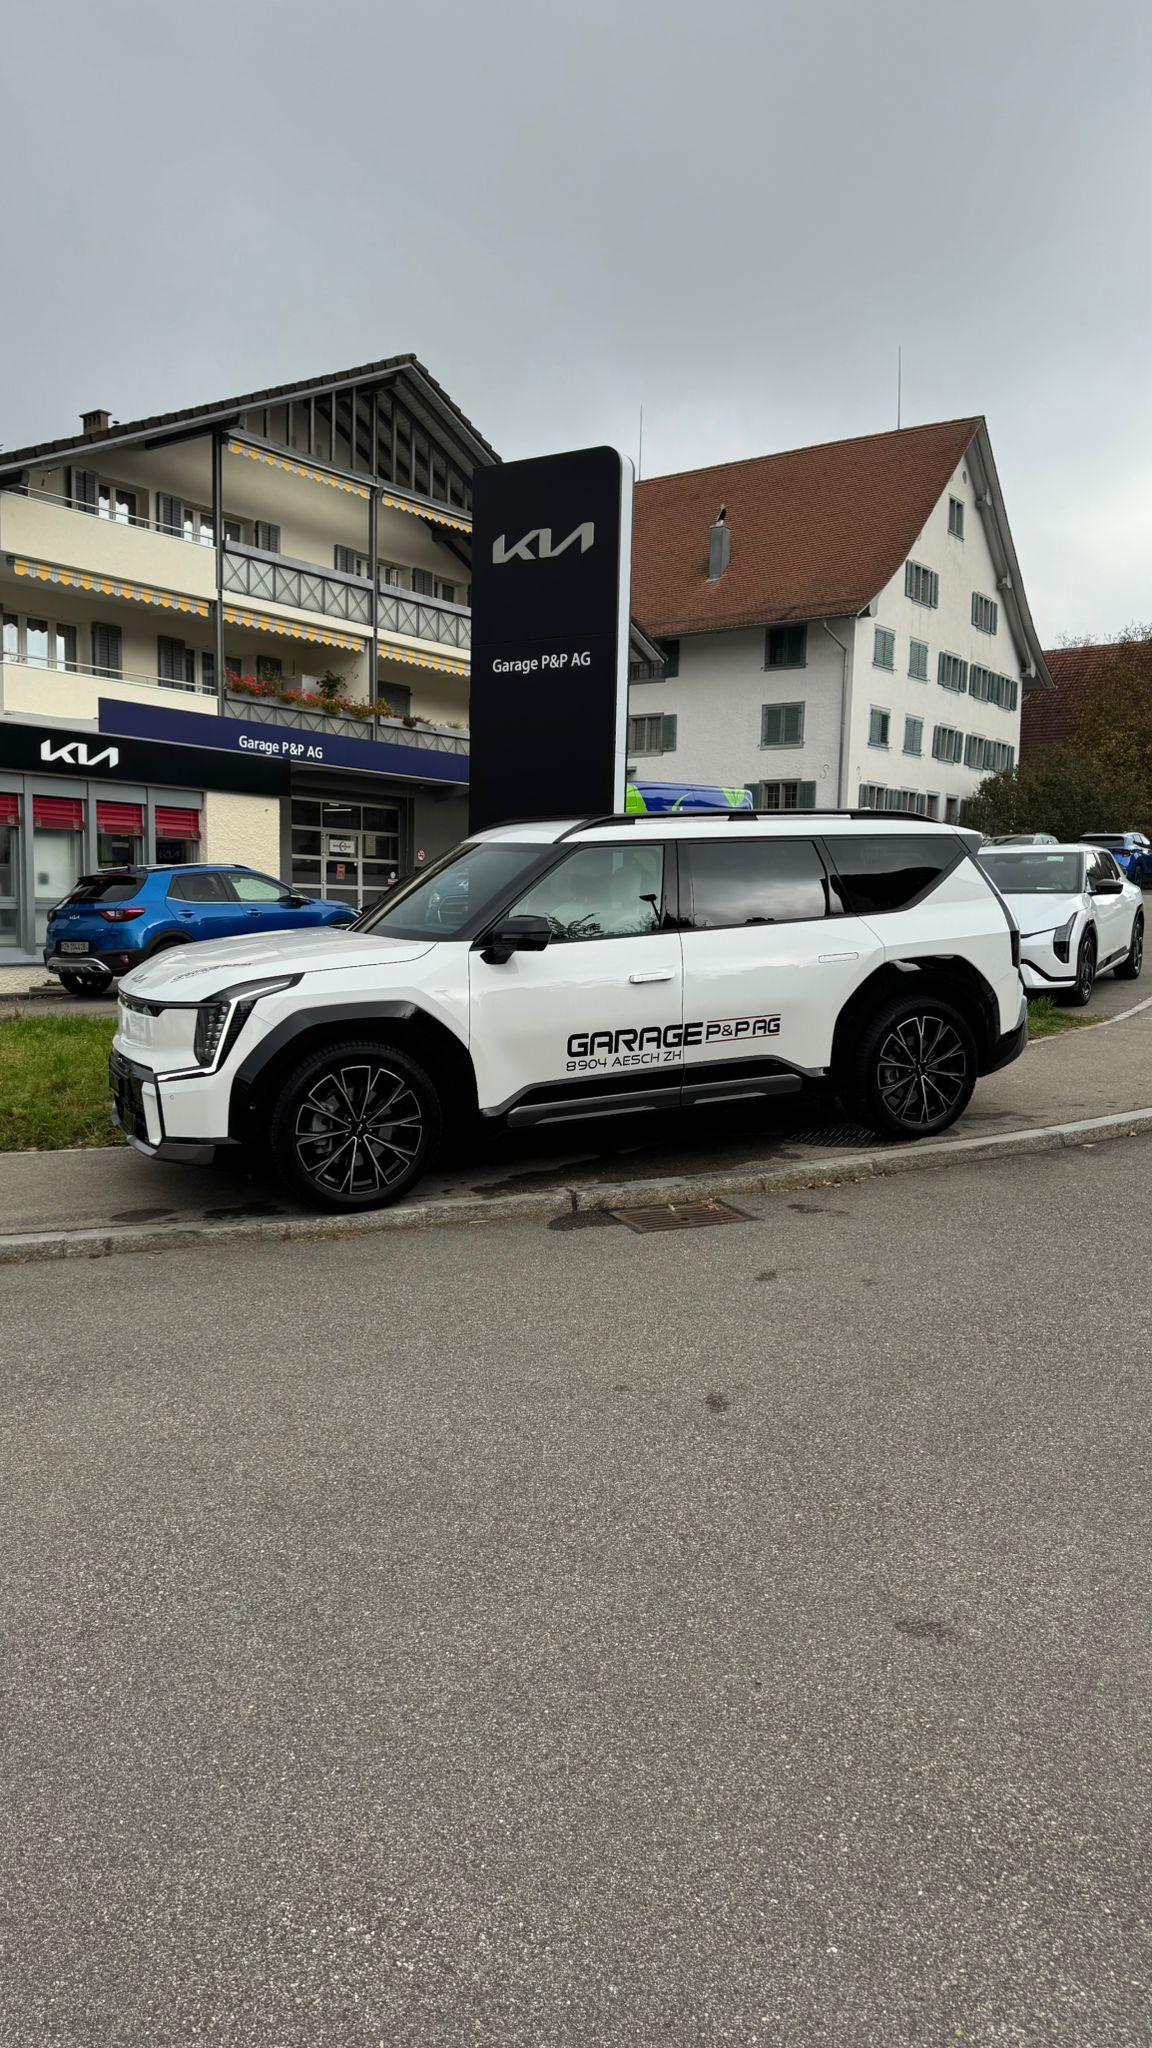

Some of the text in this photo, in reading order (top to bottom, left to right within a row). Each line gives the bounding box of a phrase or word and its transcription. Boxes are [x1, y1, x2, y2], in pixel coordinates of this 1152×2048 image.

[492, 522, 594, 564] KIA
[492, 651, 591, 674] Garage P&P AG
[40, 739, 119, 768] KIA
[238, 735, 323, 759] Garage P&P AG
[567, 1018, 781, 1058] GARAGE P&P AG
[566, 1050, 682, 1072] 8904 AESCH ZH
